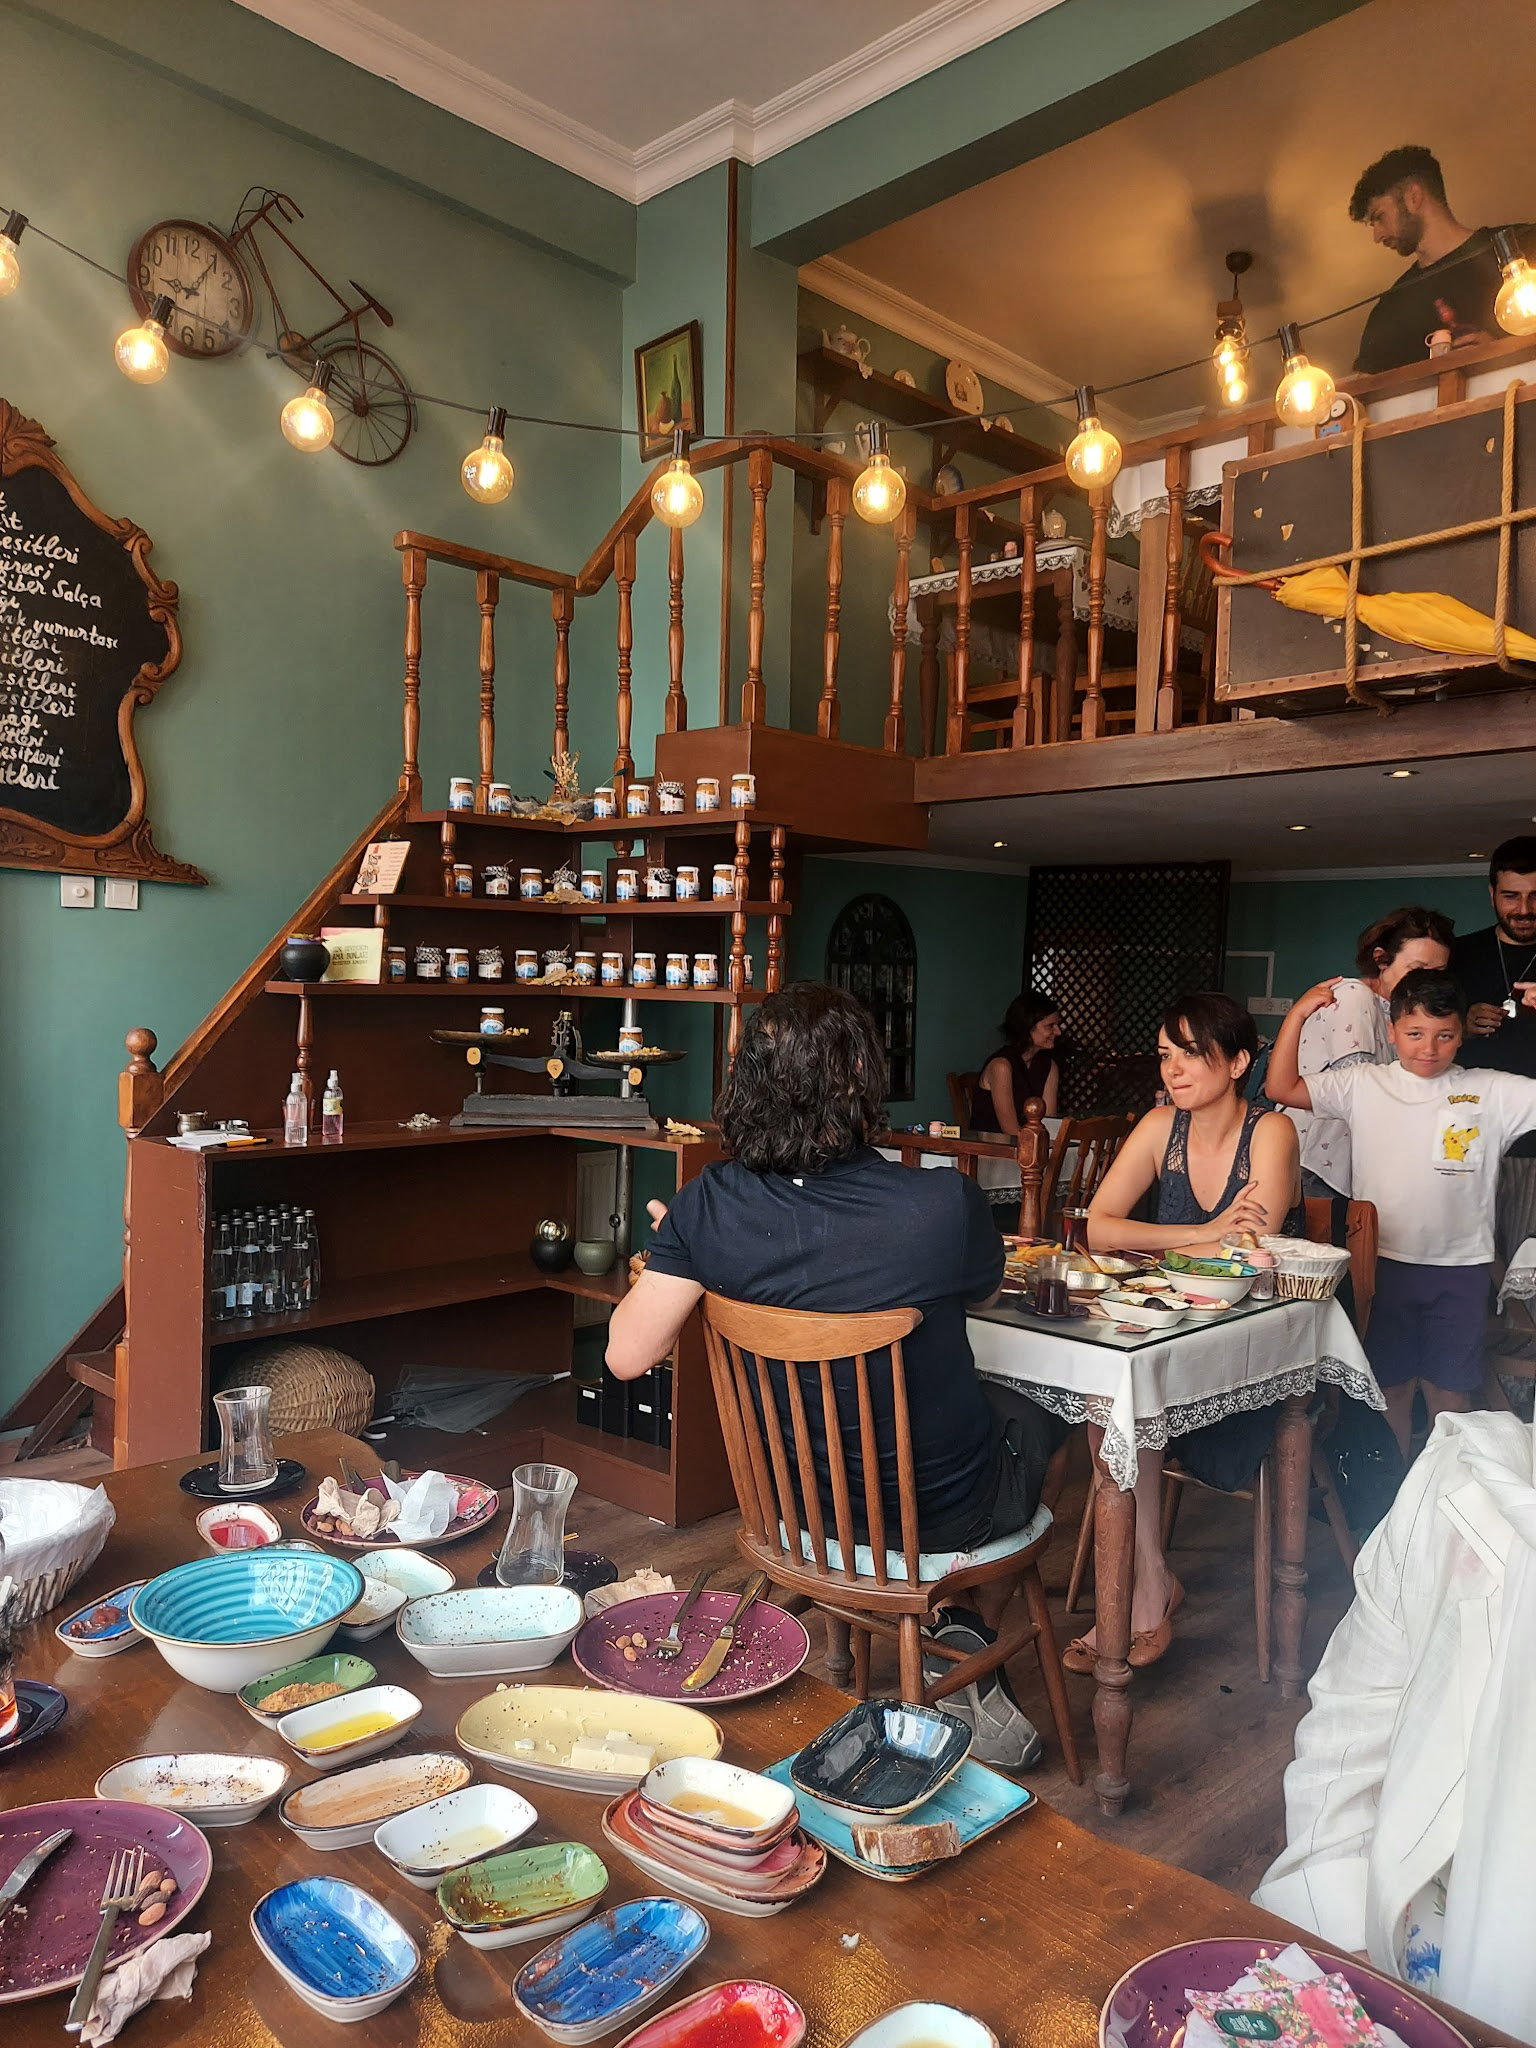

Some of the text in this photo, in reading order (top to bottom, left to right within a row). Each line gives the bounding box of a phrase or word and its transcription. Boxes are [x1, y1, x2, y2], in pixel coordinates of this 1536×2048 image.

[146, 243, 163, 267] 10
[165, 231, 177, 256] 11
[183, 235, 201, 260] 12
[139, 265, 151, 286] 9
[221, 271, 233, 292] 2
[229, 296, 241, 319] 3
[181, 325, 195, 348] 6
[204, 328, 216, 351] 5
[0, 534, 80, 565] eşitleri
[52, 579, 103, 609] Salça
[33, 619, 119, 649] yumurtası
